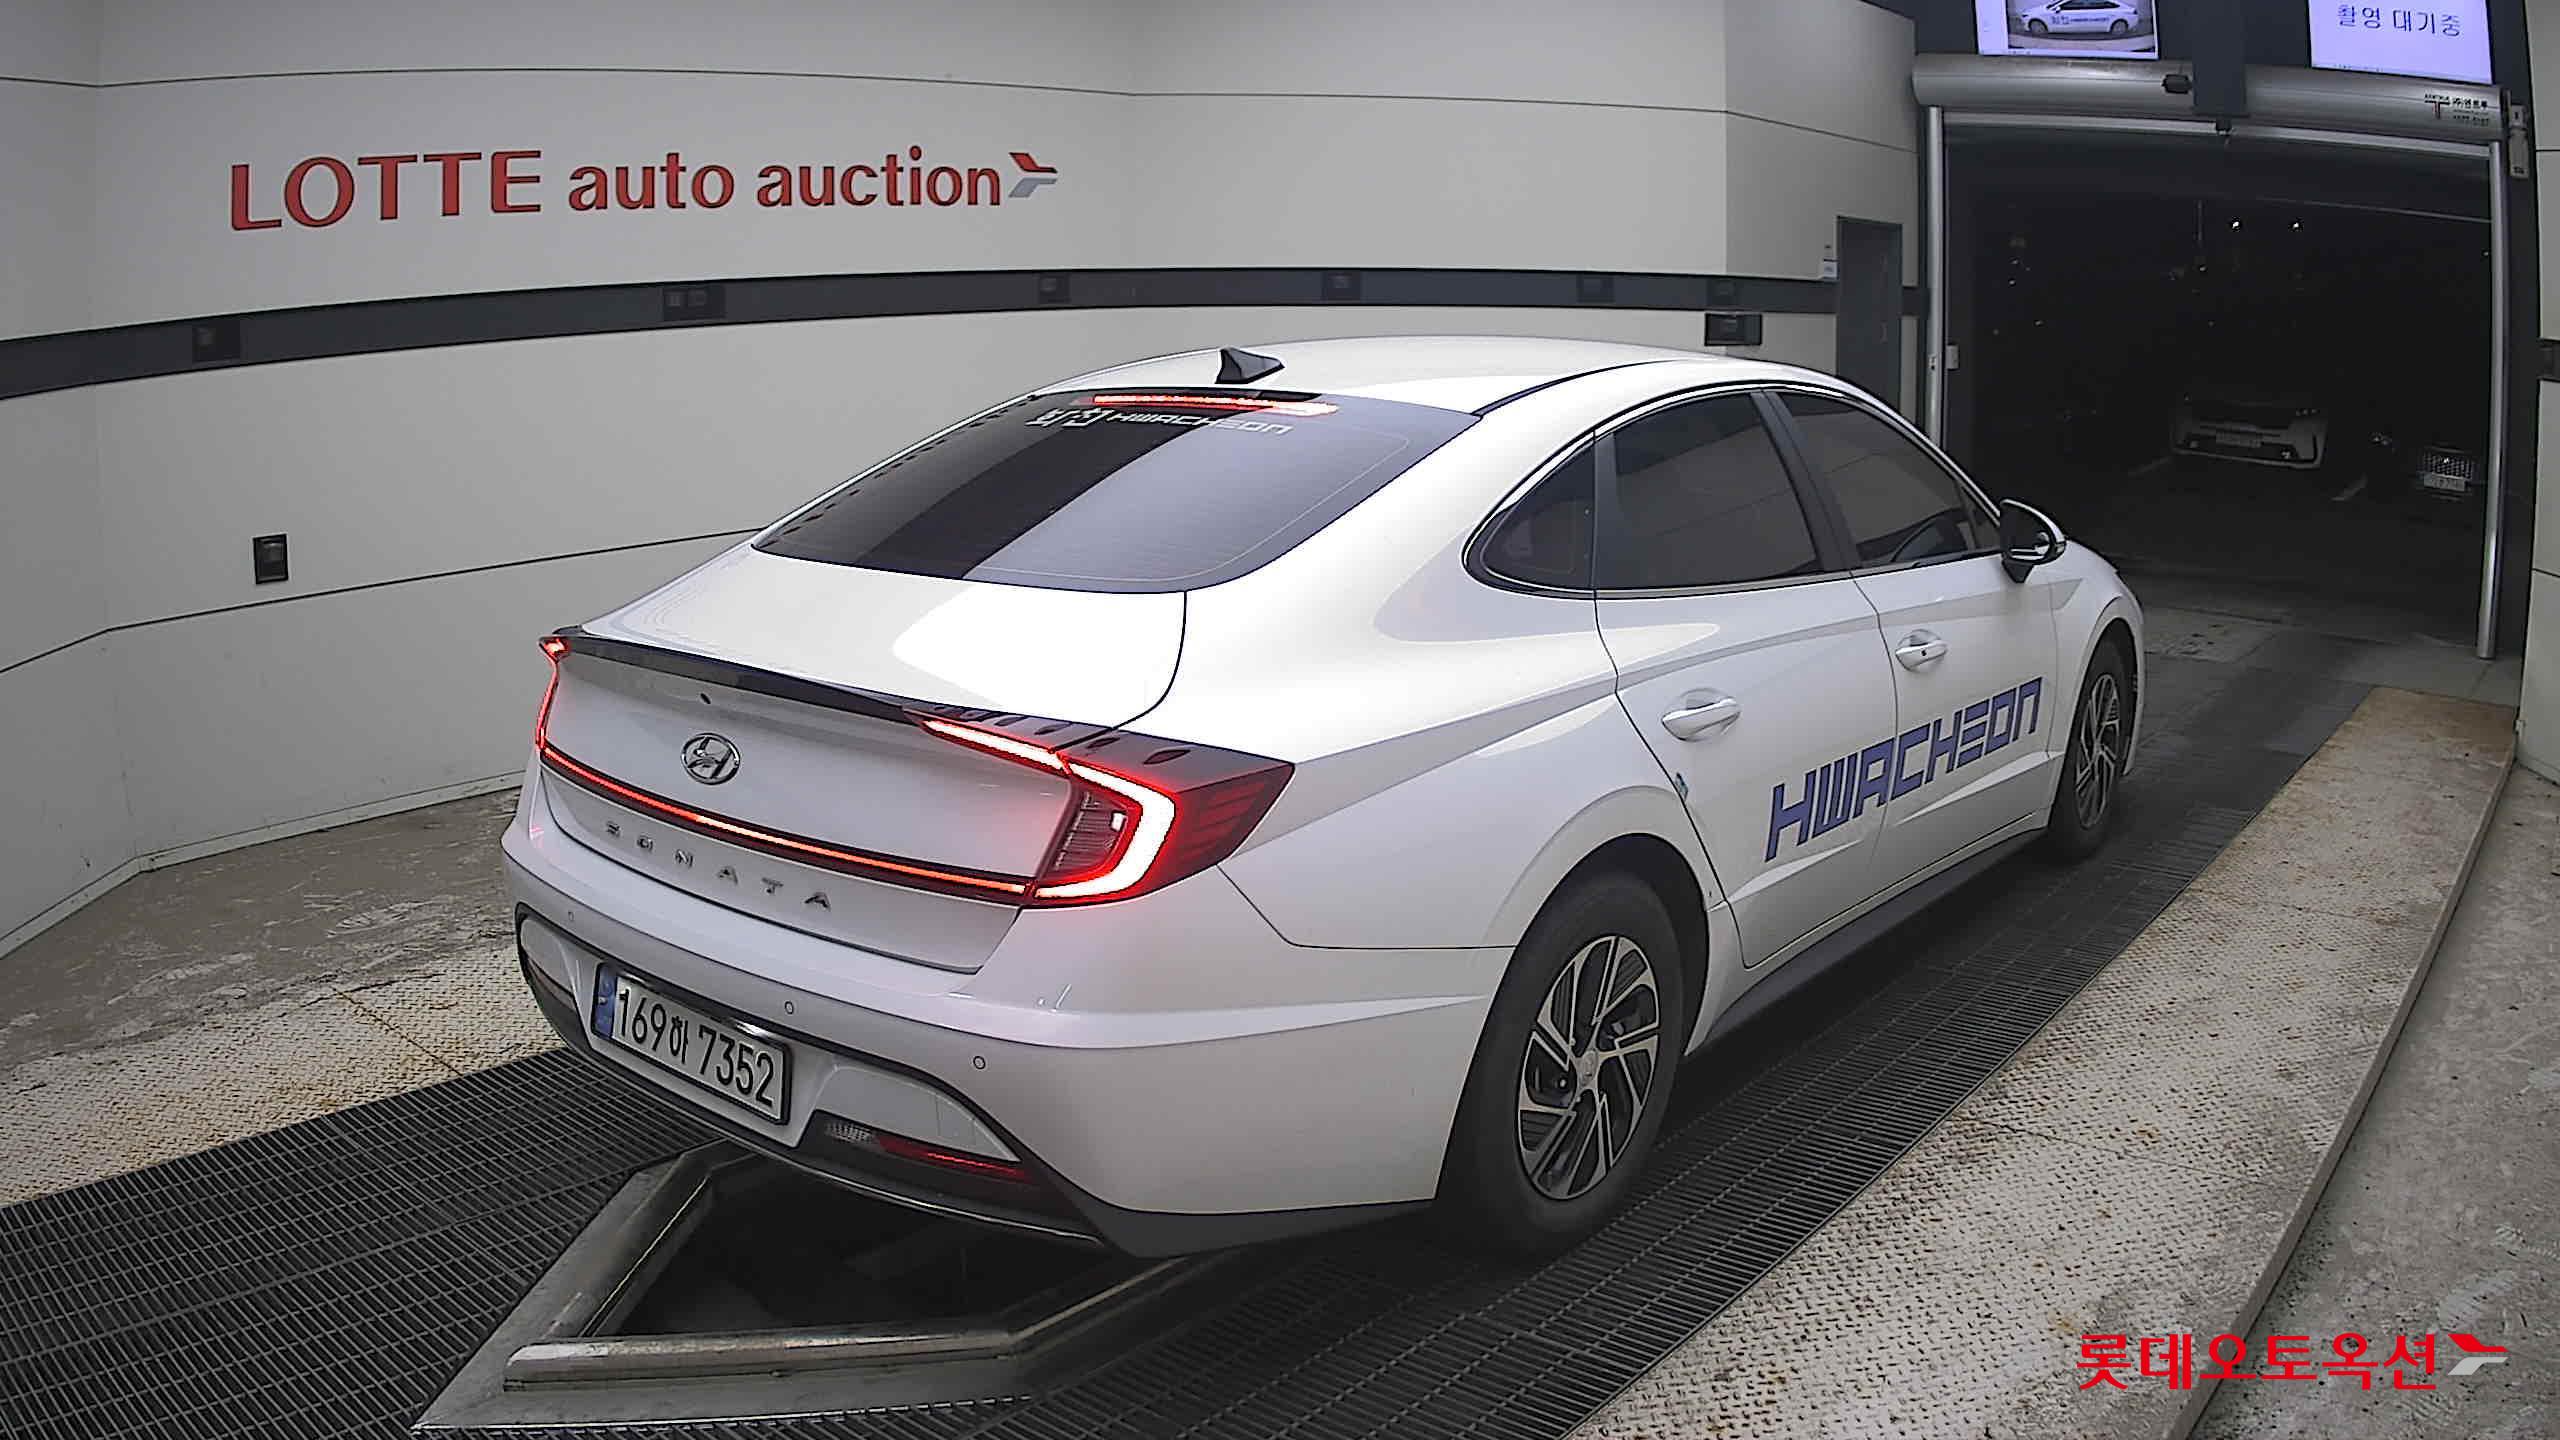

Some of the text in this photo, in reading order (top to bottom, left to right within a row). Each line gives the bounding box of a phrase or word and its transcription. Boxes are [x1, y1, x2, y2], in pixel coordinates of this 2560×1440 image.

[2338, 5, 2460, 37] 촬영 대기중
[231, 145, 1001, 231] LOTTE auto auction
[1106, 412, 1295, 435] HWACHEON
[1765, 677, 2043, 863] HWACHEON
[605, 820, 832, 912] SONATA
[618, 988, 774, 1107] 169하 7352
